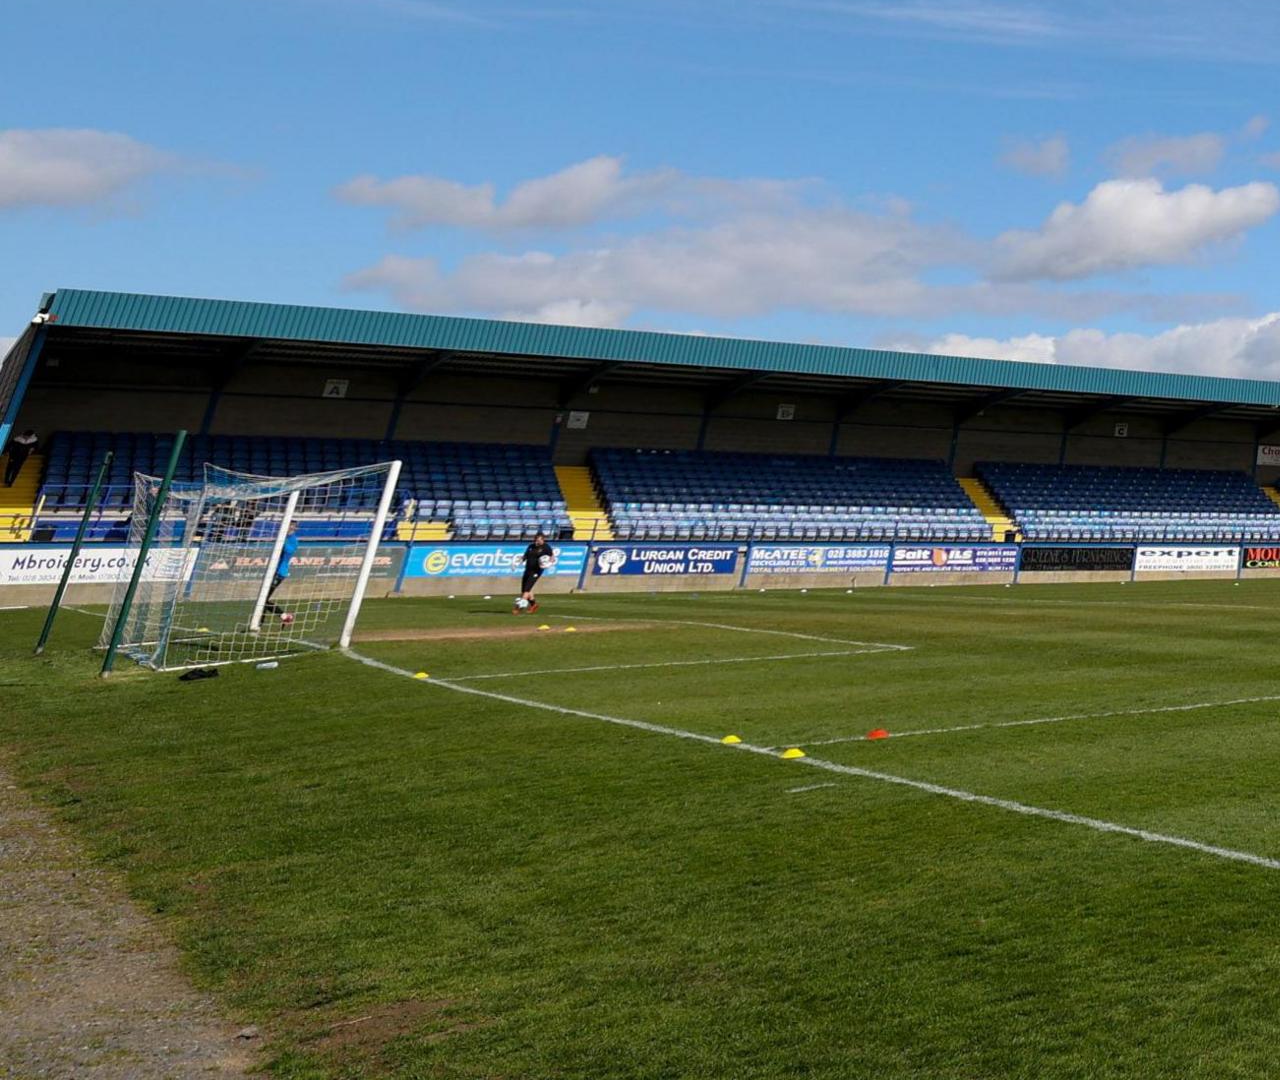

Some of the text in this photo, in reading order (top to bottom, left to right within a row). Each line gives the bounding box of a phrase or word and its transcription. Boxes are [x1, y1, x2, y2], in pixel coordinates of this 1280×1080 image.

[451, 549, 527, 567] eventse
[631, 549, 734, 560] LURGAN CREDIT
[752, 549, 808, 560] McATEE
[827, 549, 845, 559] 028
[894, 549, 931, 560] Salt
[1140, 549, 1236, 558] expert
[235, 556, 325, 566] HAANE
[643, 561, 714, 573] UNION LTD.
